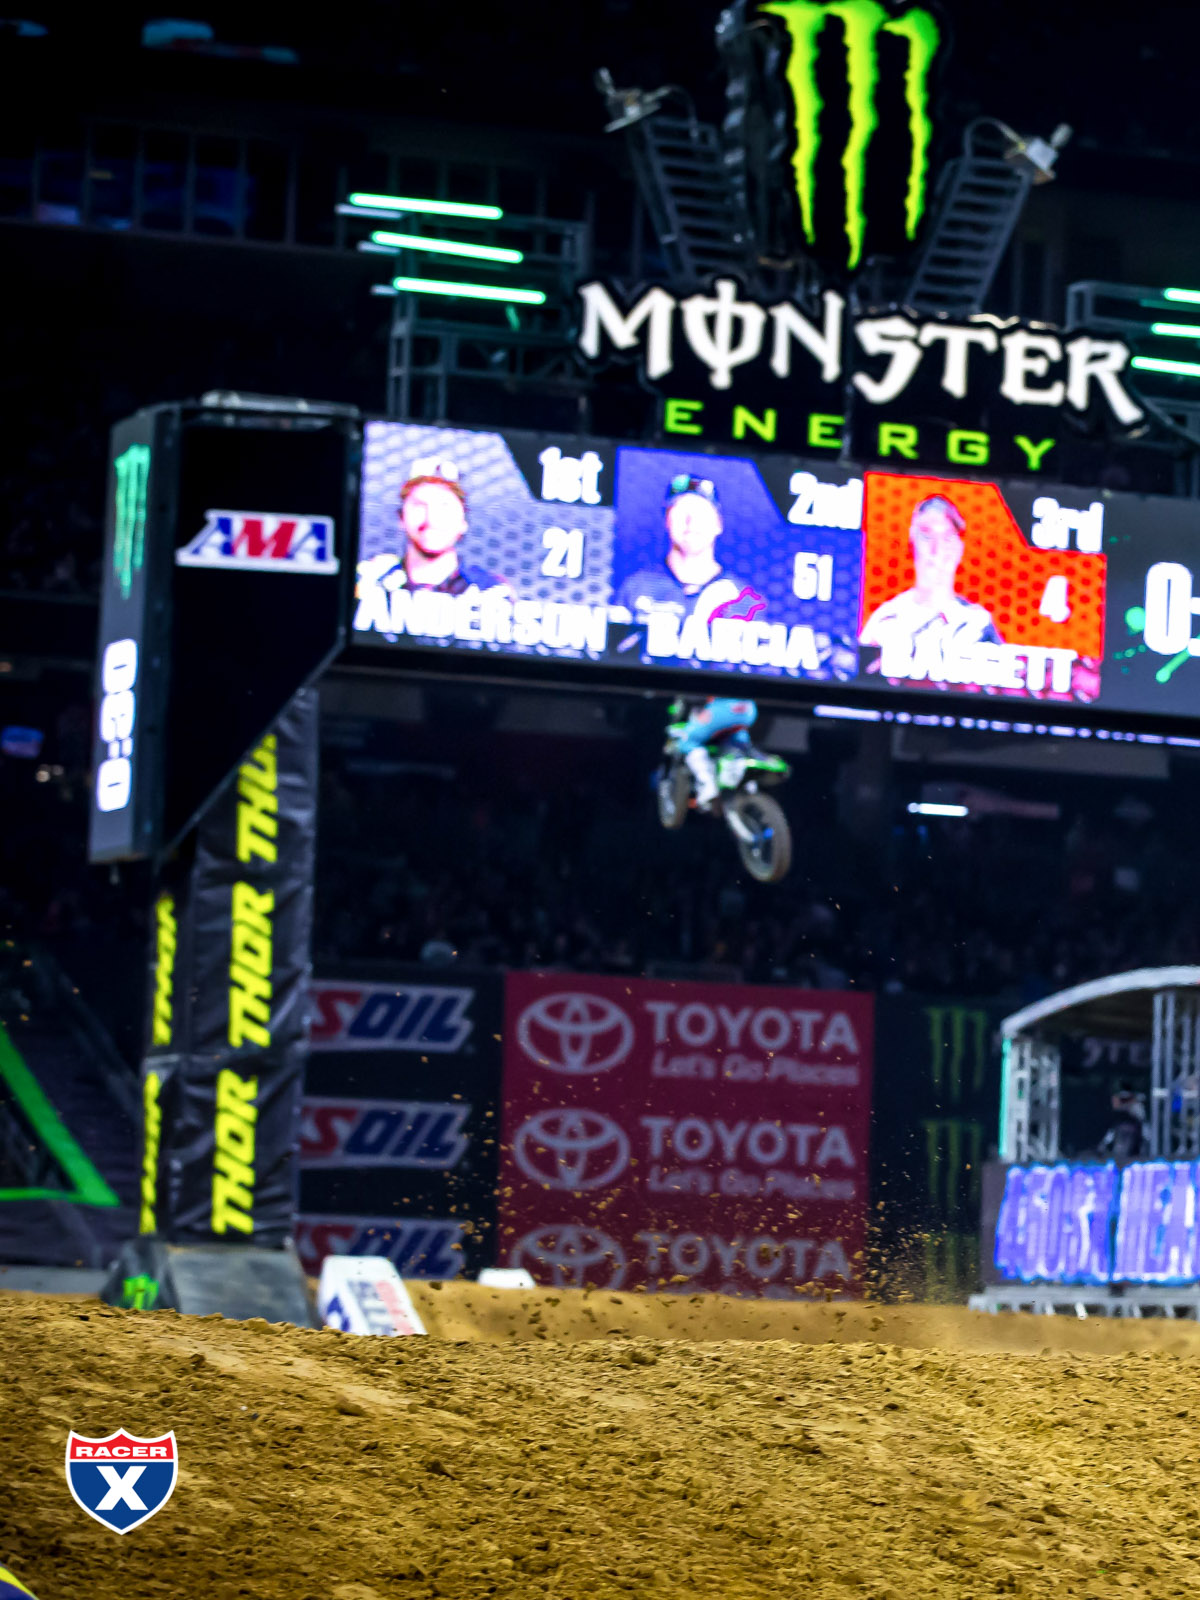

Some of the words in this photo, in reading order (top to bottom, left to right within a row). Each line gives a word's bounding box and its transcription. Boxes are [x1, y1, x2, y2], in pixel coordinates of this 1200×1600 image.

[578, 278, 1146, 424] MONSTER
[663, 397, 1056, 471] ENERGY
[539, 446, 603, 505] 1st
[184, 511, 335, 568] AMA
[541, 527, 584, 578] 21
[1031, 497, 1104, 554] 3rd
[354, 586, 607, 652] ANDERSON
[1038, 575, 1070, 623] 4
[229, 880, 274, 1047] THOR
[308, 988, 470, 1051] SOIL
[644, 1001, 860, 1056] TOYOTA
[211, 1068, 258, 1235] THOR
[640, 1116, 856, 1168] TOYOTA
[638, 1231, 852, 1281] TOYOTA
